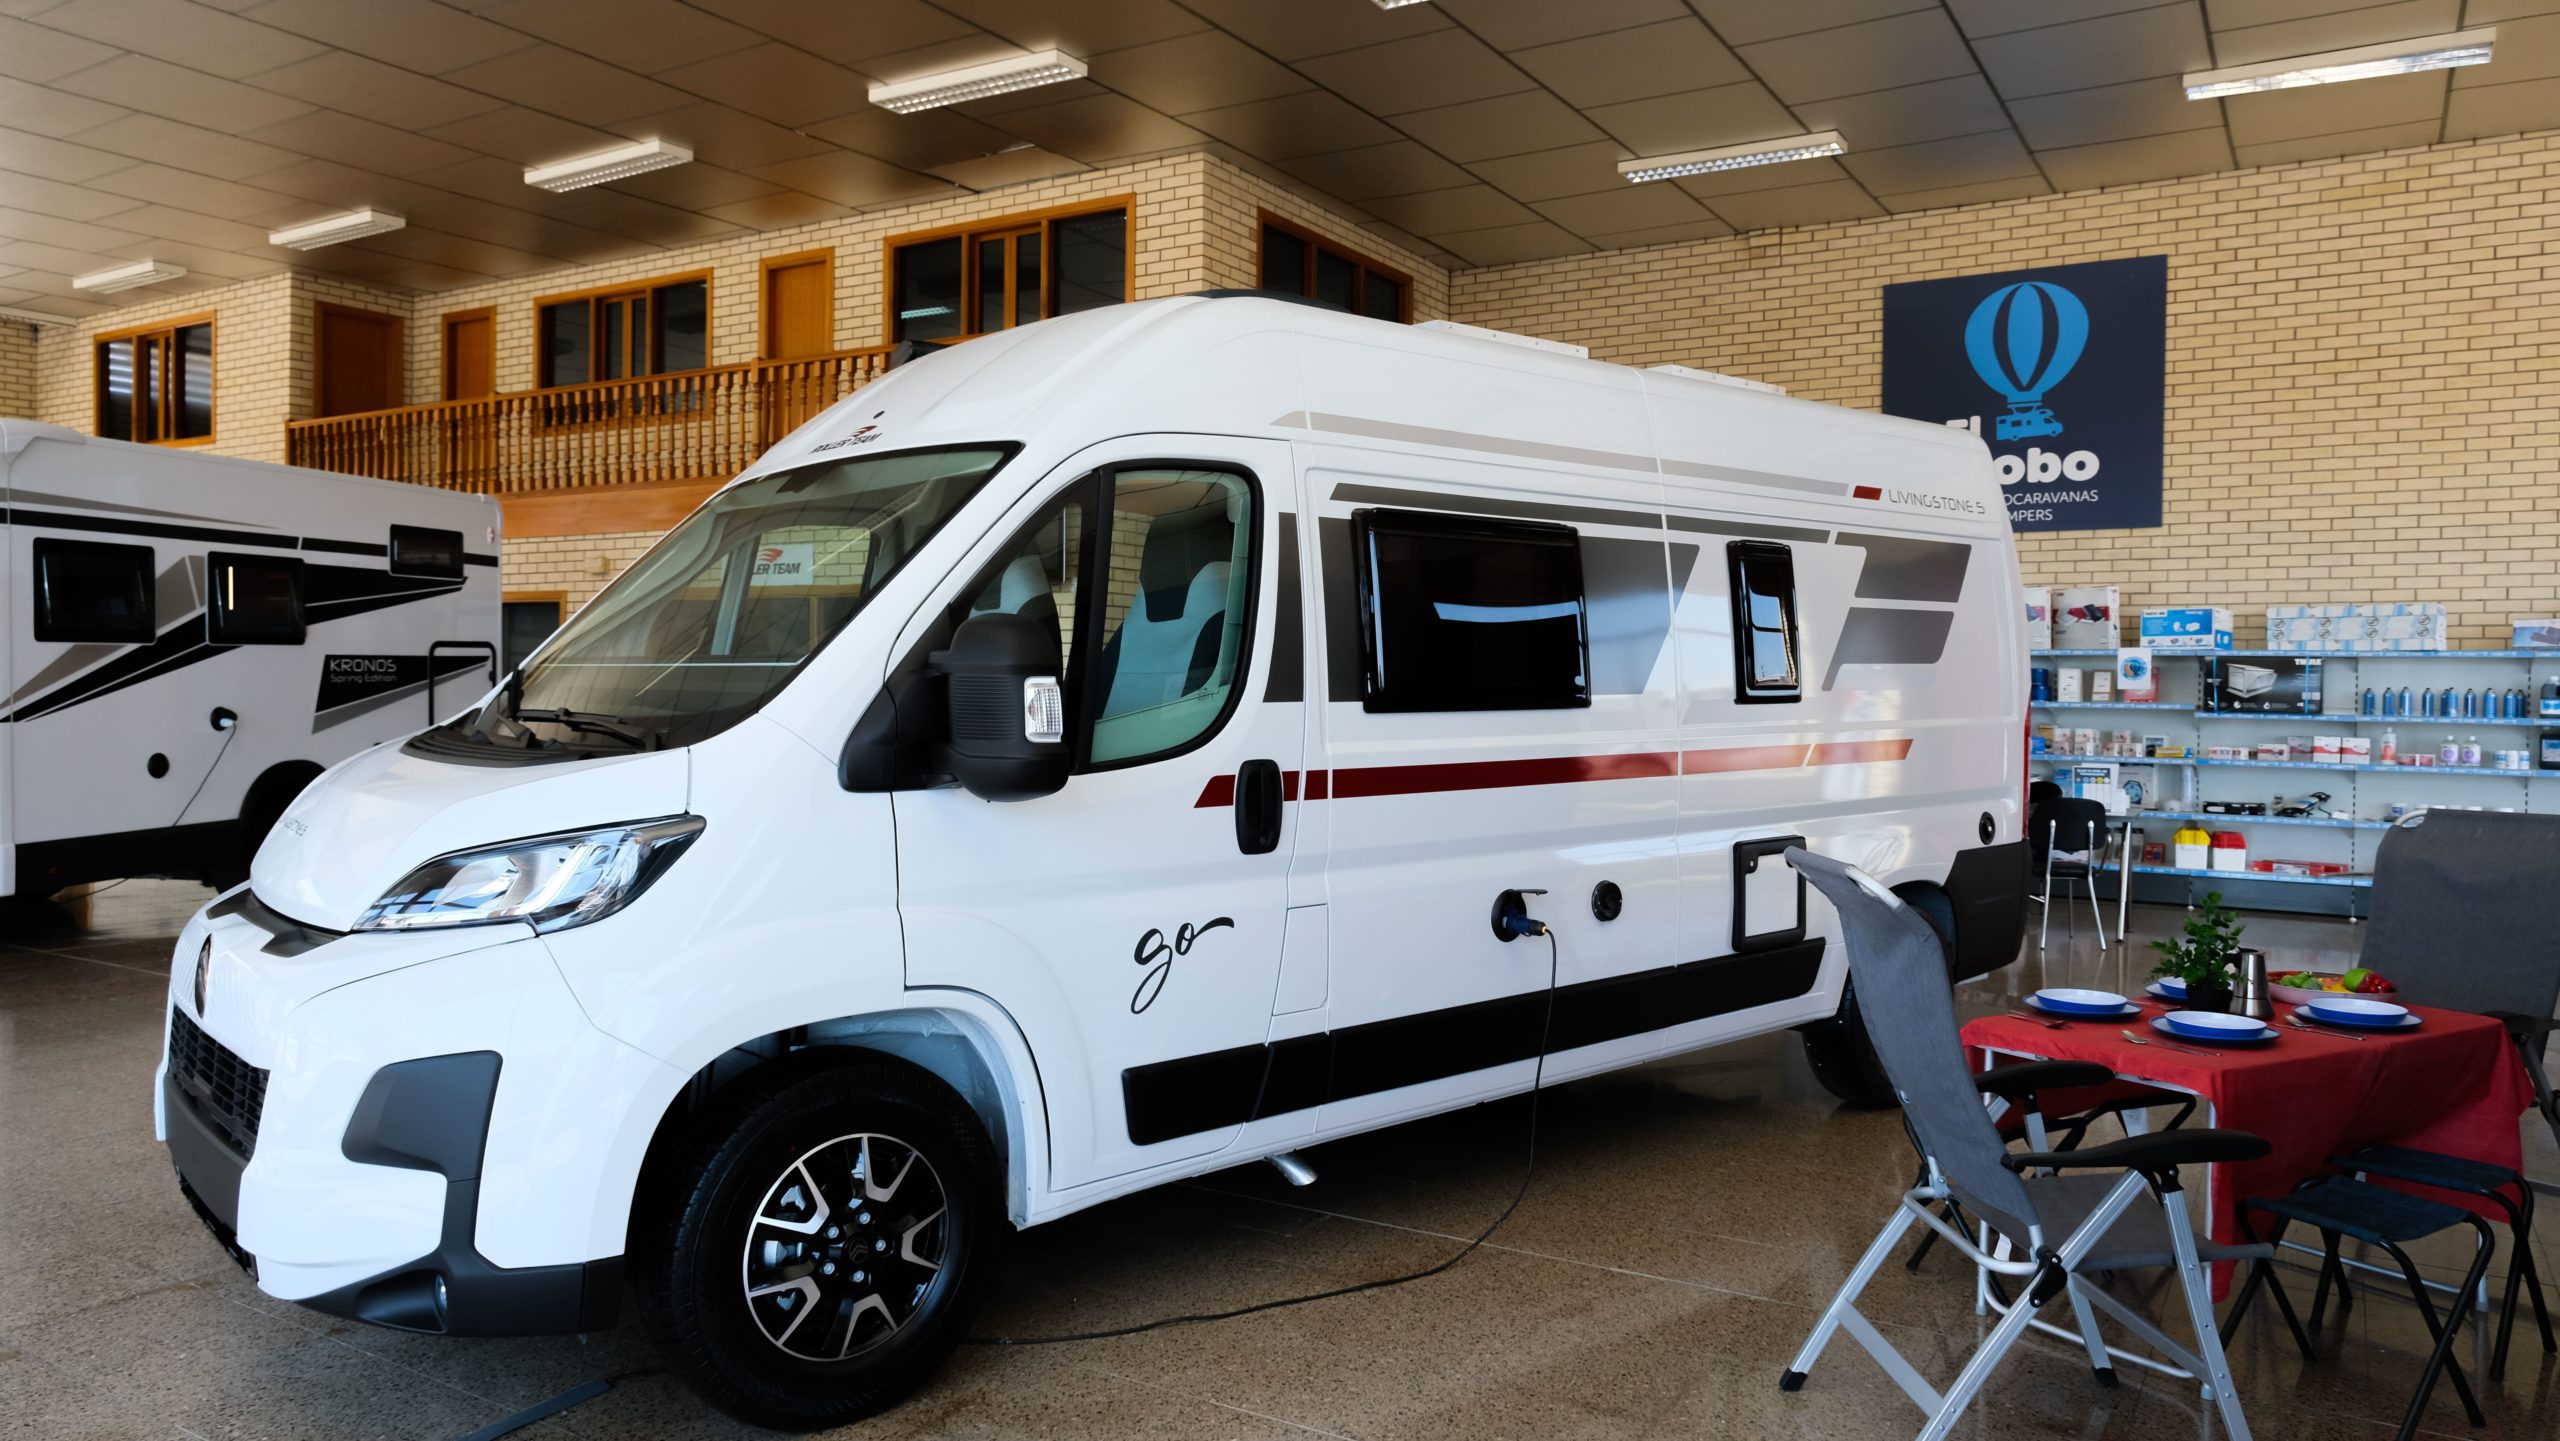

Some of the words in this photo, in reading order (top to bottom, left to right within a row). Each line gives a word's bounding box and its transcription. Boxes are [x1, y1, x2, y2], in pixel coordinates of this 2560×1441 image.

[1993, 447, 2100, 485] obo
[1888, 489, 1974, 513] LIVINGSTONE
[2003, 489, 2099, 505] OCARAVANAS
[2008, 509, 2054, 522] MPERS
[752, 563, 771, 575] LER
[773, 562, 801, 575] TEAM
[330, 659, 397, 672] KRONOS
[330, 673, 363, 684] Spring
[364, 673, 397, 682] Edition
[1130, 916, 1235, 1015] go
